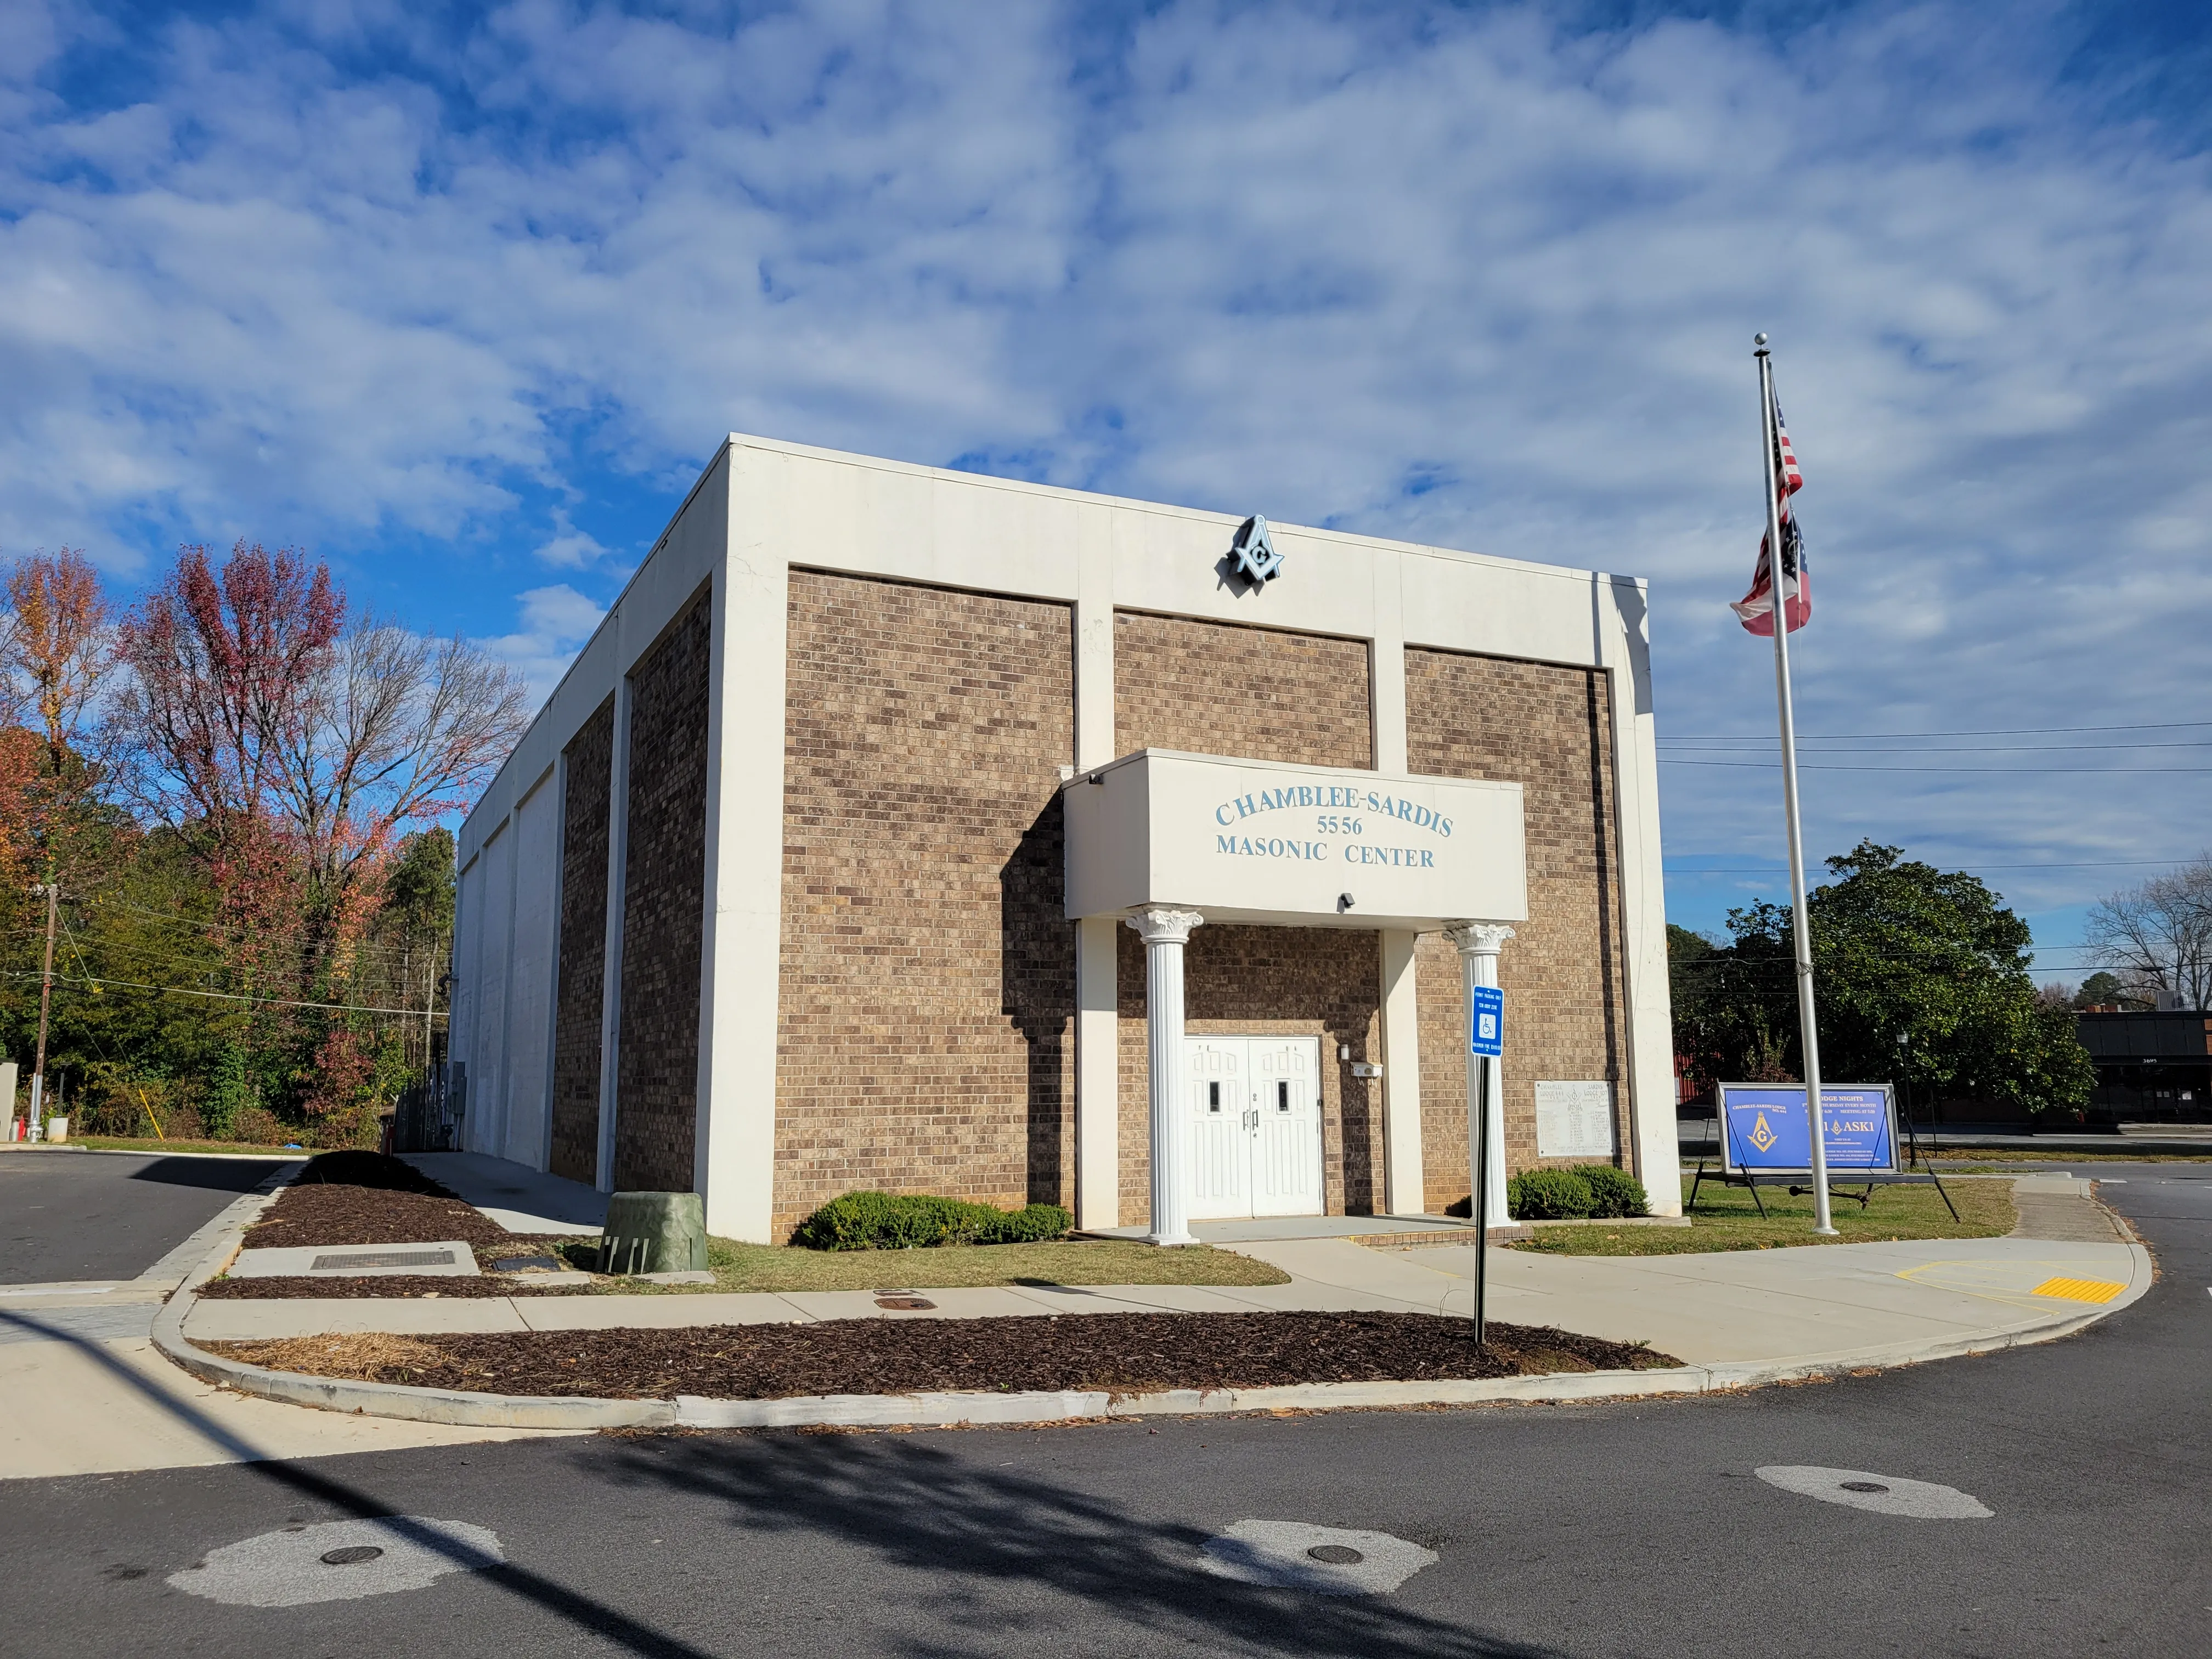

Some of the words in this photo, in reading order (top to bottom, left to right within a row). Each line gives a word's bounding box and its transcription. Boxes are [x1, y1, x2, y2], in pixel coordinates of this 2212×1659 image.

[1215, 786, 1454, 838] CHAMBLEE-SARDIS
[1317, 815, 1363, 835] 5556
[1216, 834, 1328, 861] MASONIC
[1344, 844, 1435, 868] CENTER
[1844, 1121, 1874, 1131] ASK1
[1757, 1131, 1767, 1142] G
